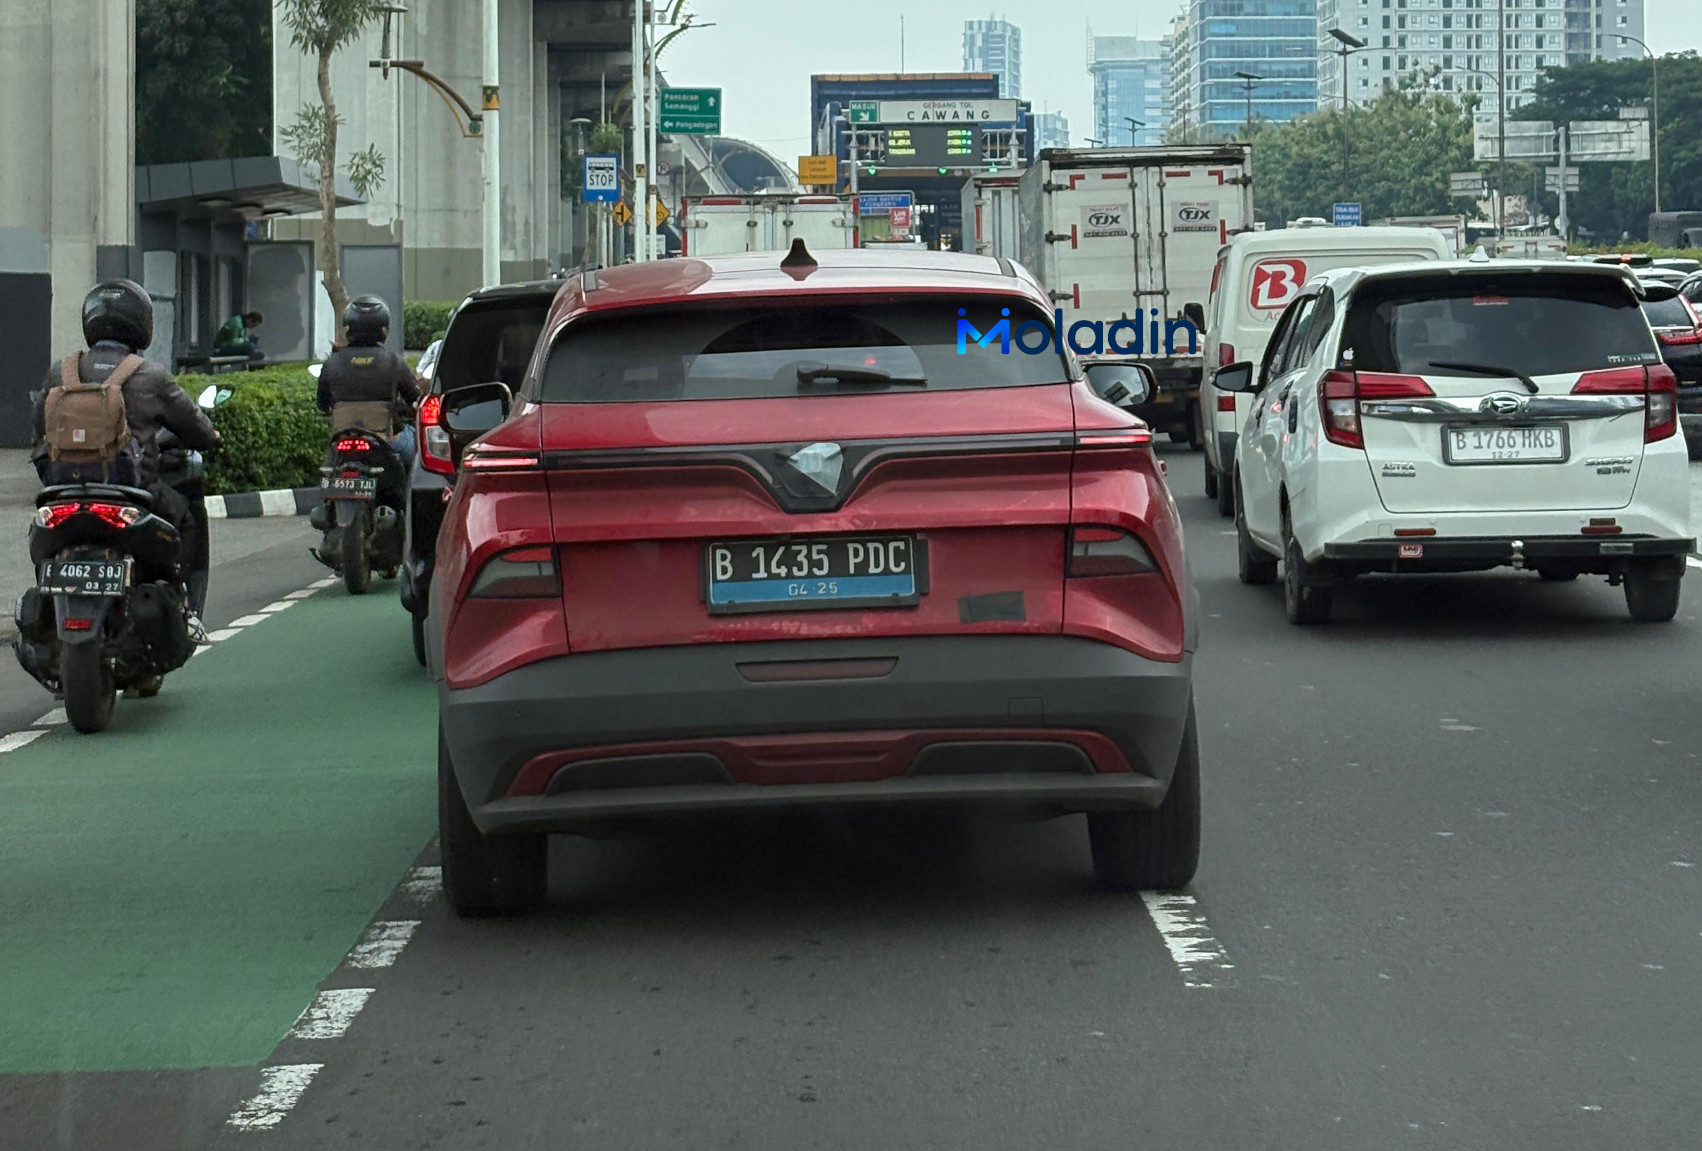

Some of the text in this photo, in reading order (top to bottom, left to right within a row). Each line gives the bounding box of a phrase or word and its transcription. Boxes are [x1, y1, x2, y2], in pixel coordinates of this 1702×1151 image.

[665, 93, 699, 101] Pancoran
[665, 103, 699, 111] Semanggi
[907, 110, 990, 121] CAWANG
[589, 174, 614, 186] STOP
[1094, 214, 1121, 225] TJX
[1184, 209, 1211, 220] TJX
[1456, 429, 1555, 450] B 1766 HKB
[715, 541, 906, 580] B 1435 PDC
[60, 564, 91, 577] 4062
